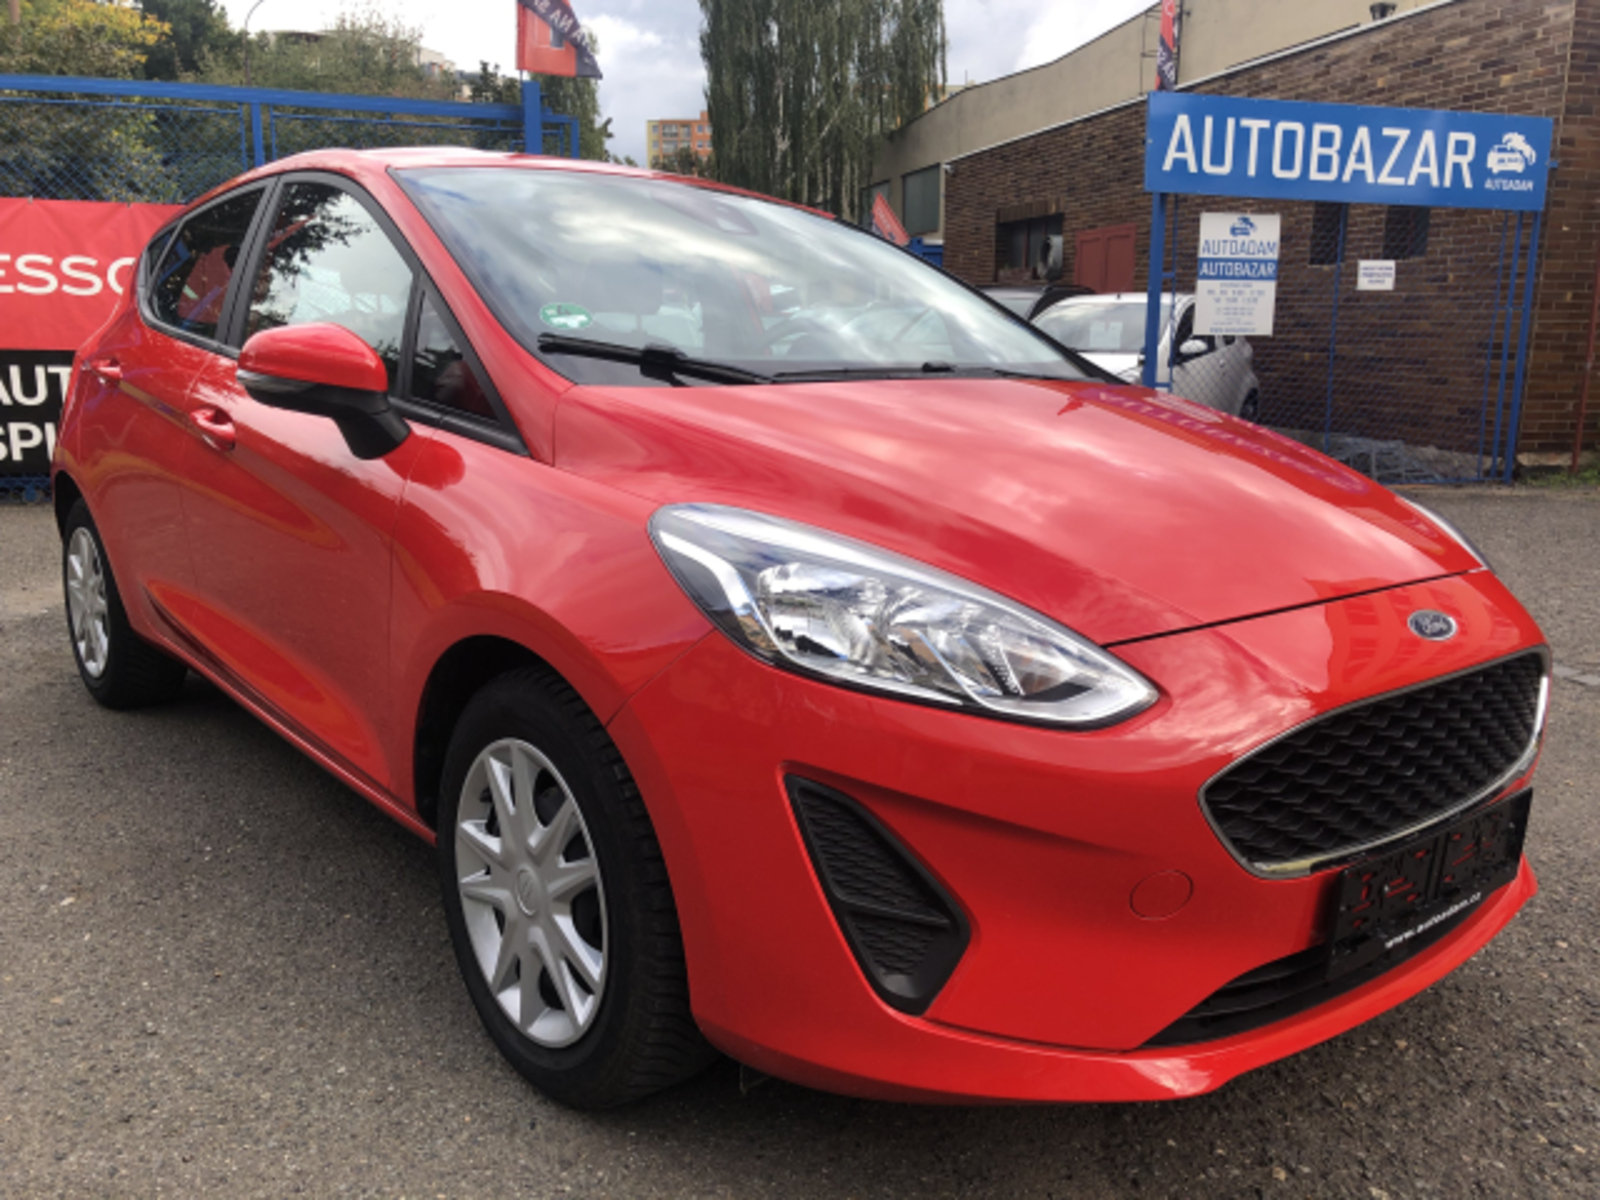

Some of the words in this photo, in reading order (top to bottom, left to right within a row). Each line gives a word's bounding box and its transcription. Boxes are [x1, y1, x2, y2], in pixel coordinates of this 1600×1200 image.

[1162, 114, 1477, 189] AUTOBAZAR
[1202, 239, 1277, 256] AUTOADAM
[1199, 262, 1276, 278] AUTOBAZAR
